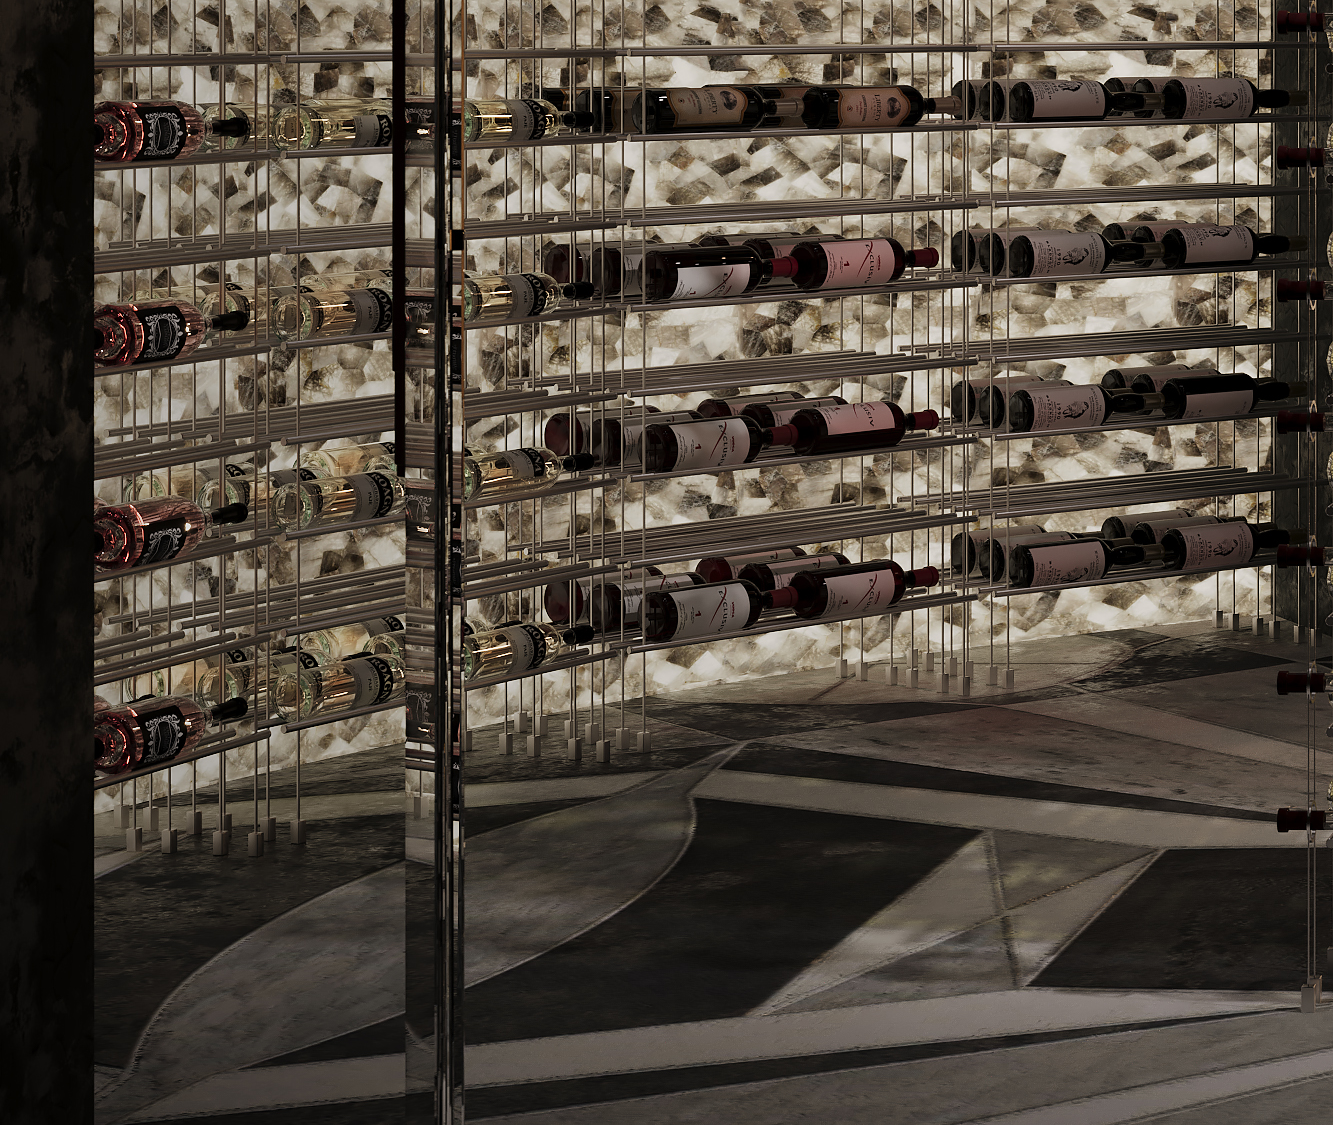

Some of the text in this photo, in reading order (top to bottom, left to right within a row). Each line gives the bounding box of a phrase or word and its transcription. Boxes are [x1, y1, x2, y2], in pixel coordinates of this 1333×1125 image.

[705, 89, 718, 115] LIBERTY
[874, 94, 882, 121] LIBERTY
[865, 244, 875, 284] EXCLUSIV
[717, 424, 728, 466] EXCLUSIV
[717, 590, 728, 632] EXCLUSIV
